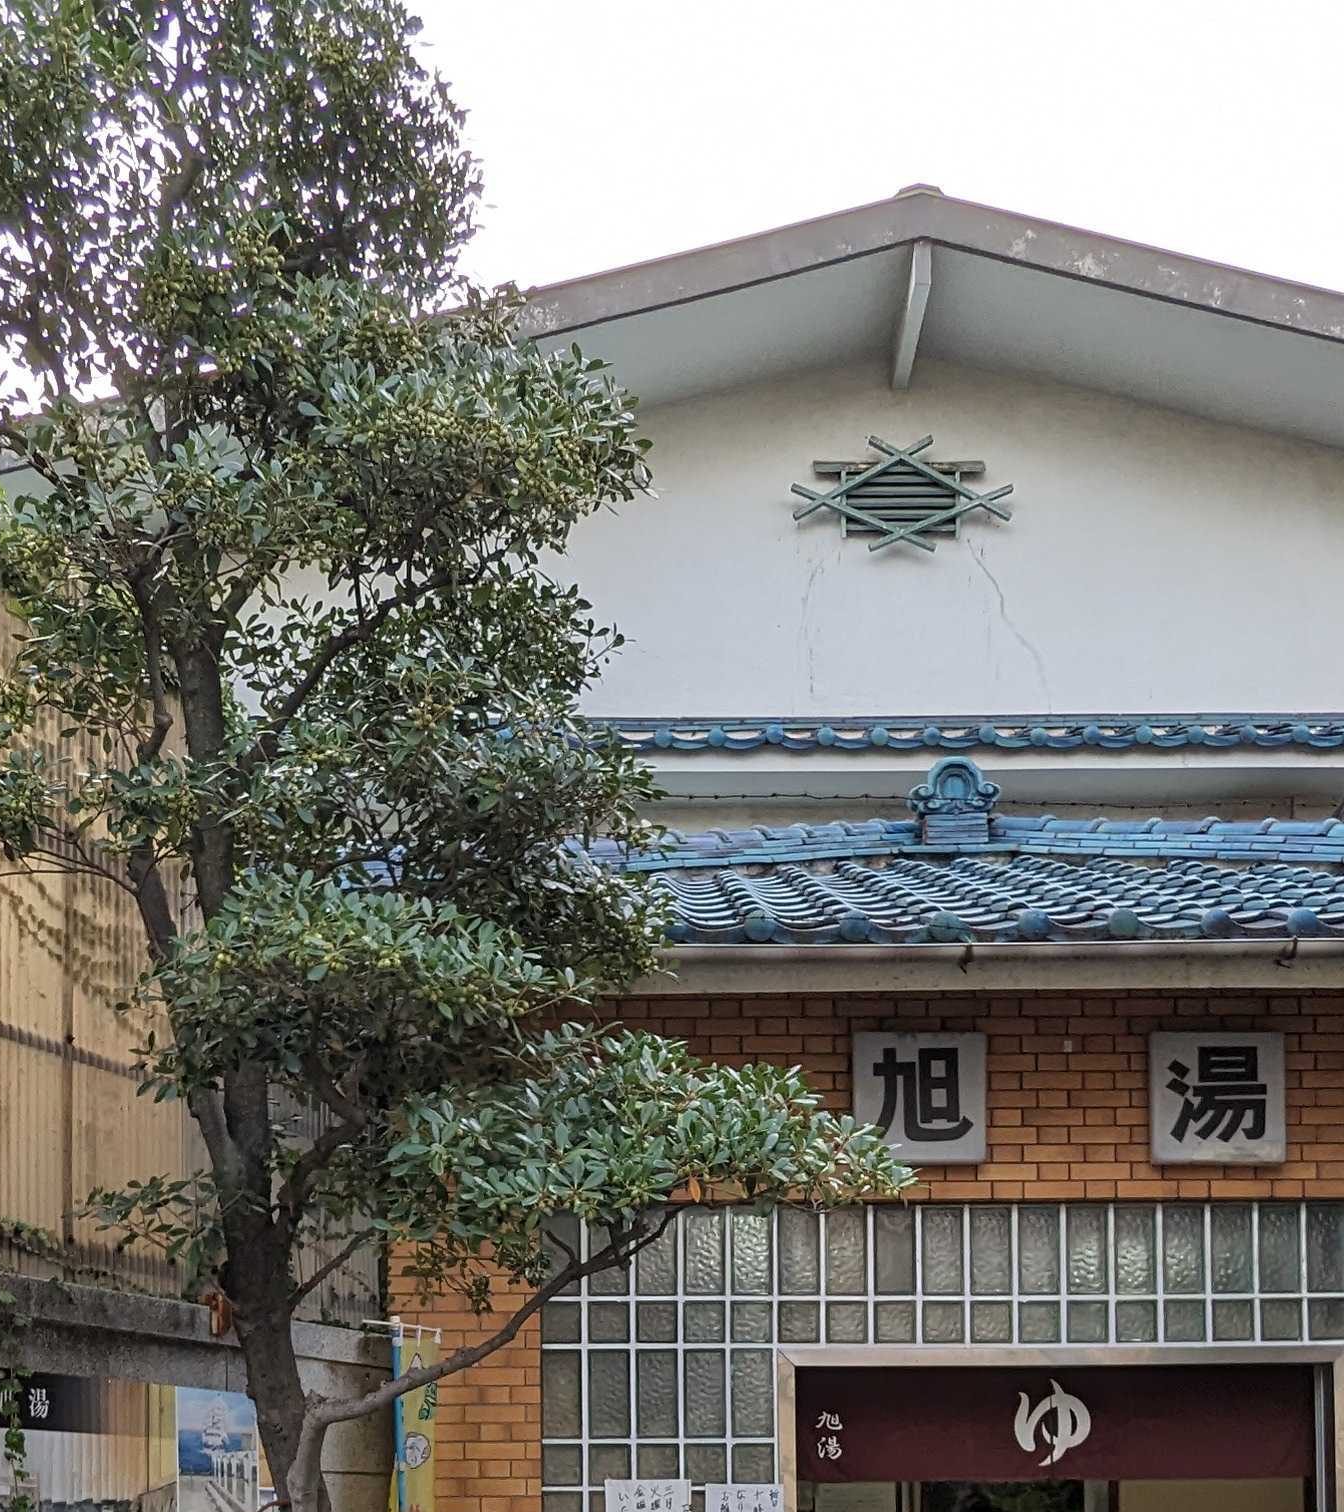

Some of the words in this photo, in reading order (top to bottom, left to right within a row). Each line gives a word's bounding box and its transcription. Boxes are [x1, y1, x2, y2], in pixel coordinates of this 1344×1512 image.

[873, 1046, 973, 1142] 旭
[1166, 1046, 1269, 1142] 湯
[816, 1411, 844, 1460] 旭湯
[1014, 1378, 1092, 1467] ゆ
